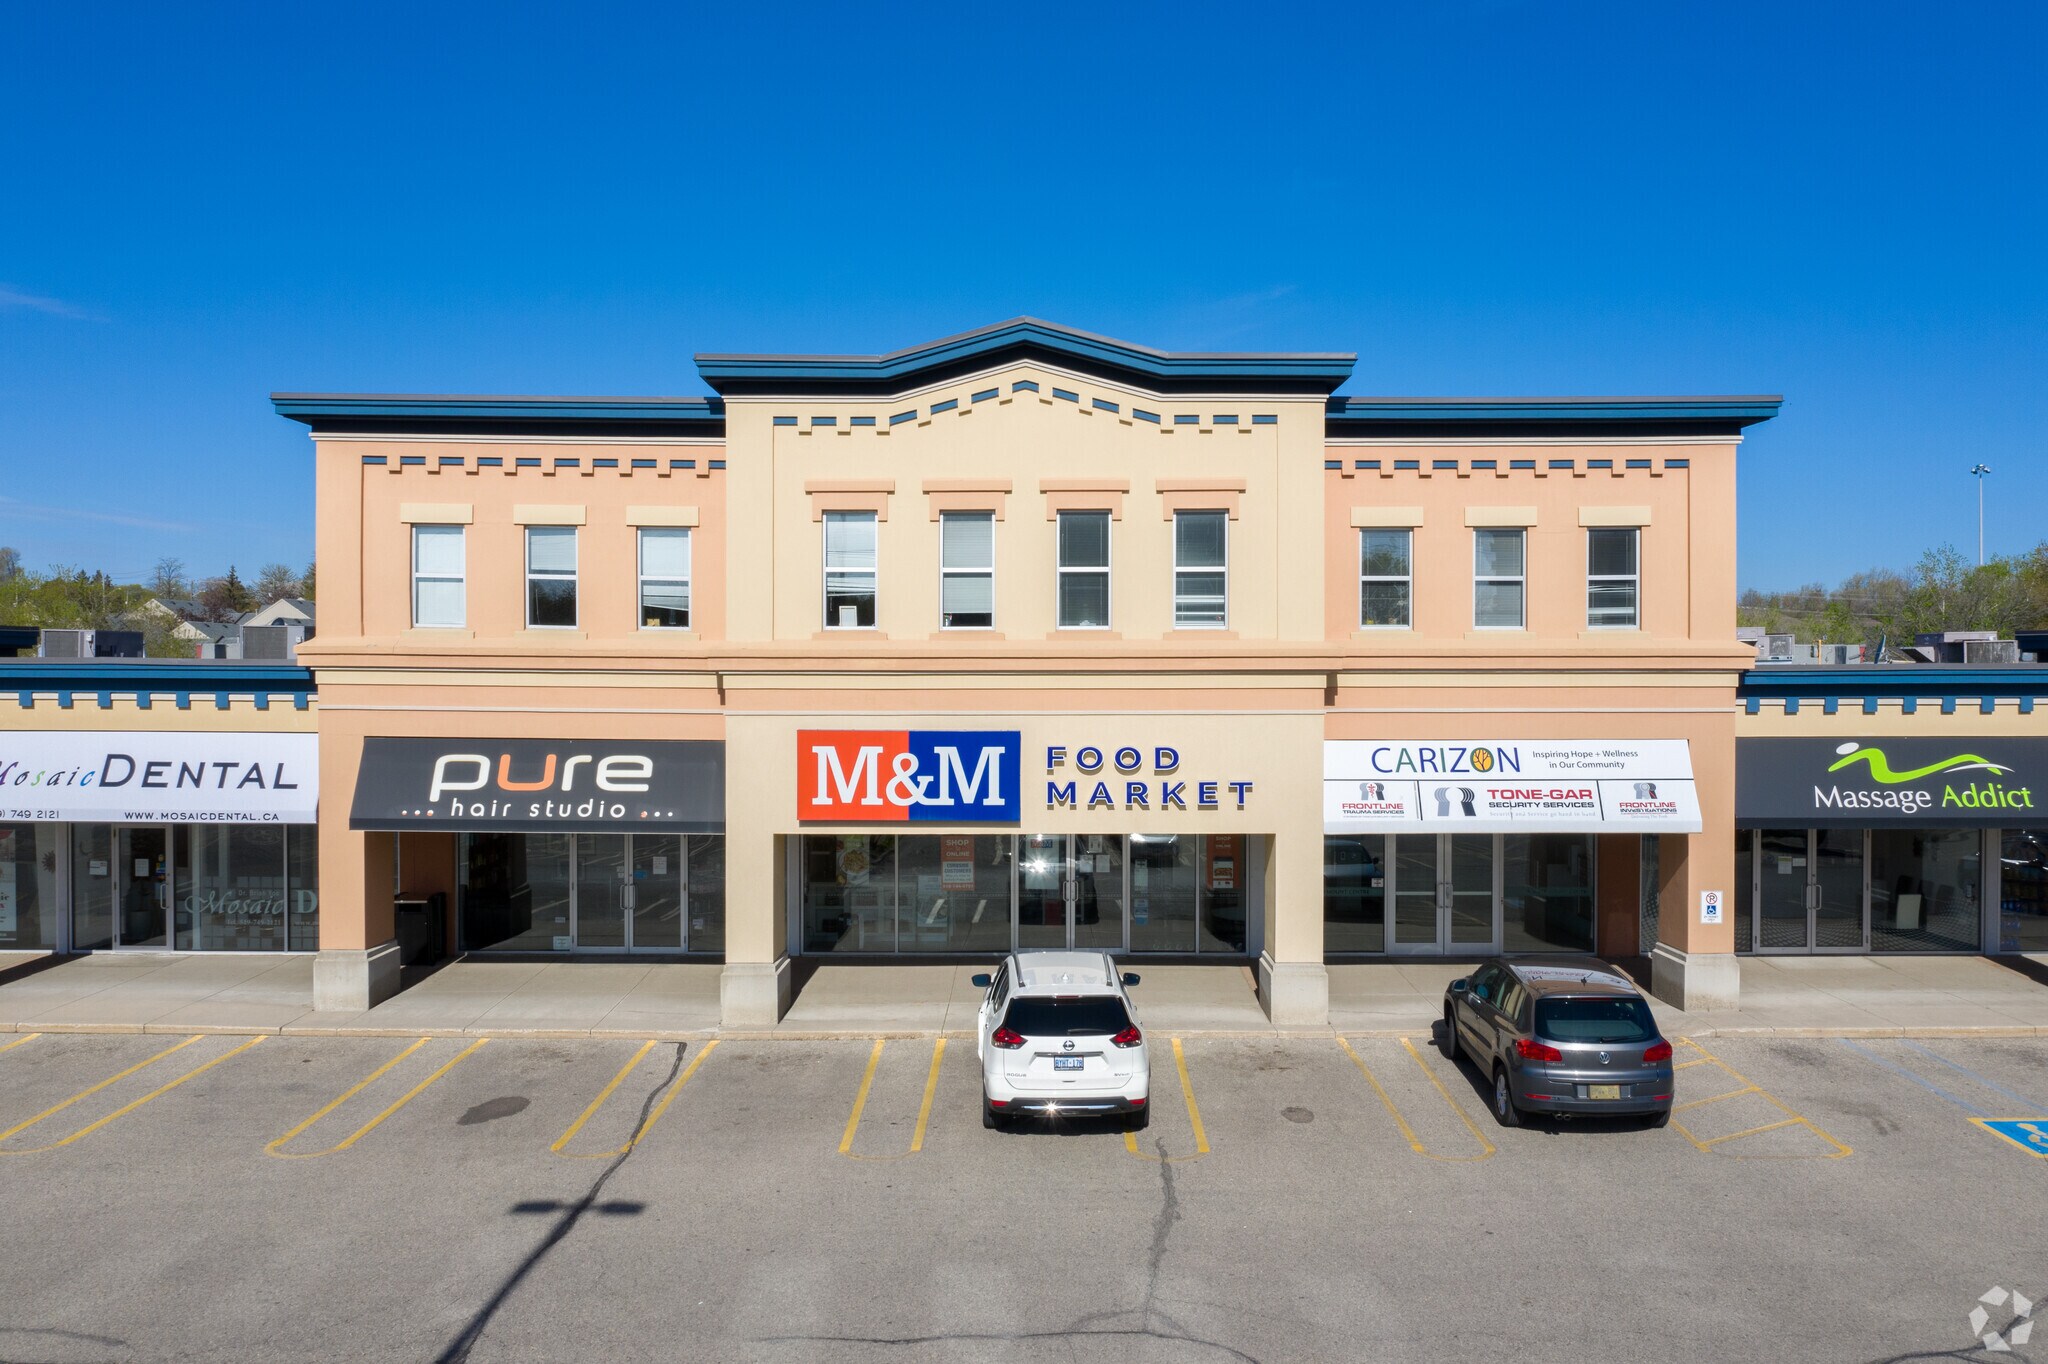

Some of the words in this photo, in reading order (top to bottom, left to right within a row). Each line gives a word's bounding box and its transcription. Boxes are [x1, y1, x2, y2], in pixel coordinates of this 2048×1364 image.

[1046, 745, 1181, 771] FOOD
[1371, 747, 1521, 773] CARIZON
[1533, 750, 1569, 760] Inspiring
[1571, 750, 1593, 760] Hope
[1602, 749, 1639, 758] Wellness
[1549, 760, 1557, 768] in
[1559, 760, 1574, 768] Our
[1576, 760, 1625, 770] Community
[429, 753, 654, 802] pure
[811, 745, 1006, 806] M&M
[1046, 780, 1254, 806] MARKET
[1486, 789, 1593, 800] TONE-GAR
[1813, 785, 1932, 814] Massage
[1941, 782, 2034, 809] Addict
[11, 809, 32, 819] 749
[37, 810, 60, 819] 2121
[124, 811, 280, 821] WWW.MOSAICDENTAL.CA
[450, 798, 511, 817] hair
[529, 798, 626, 818] studio
[184, 890, 286, 915] Mosaic
